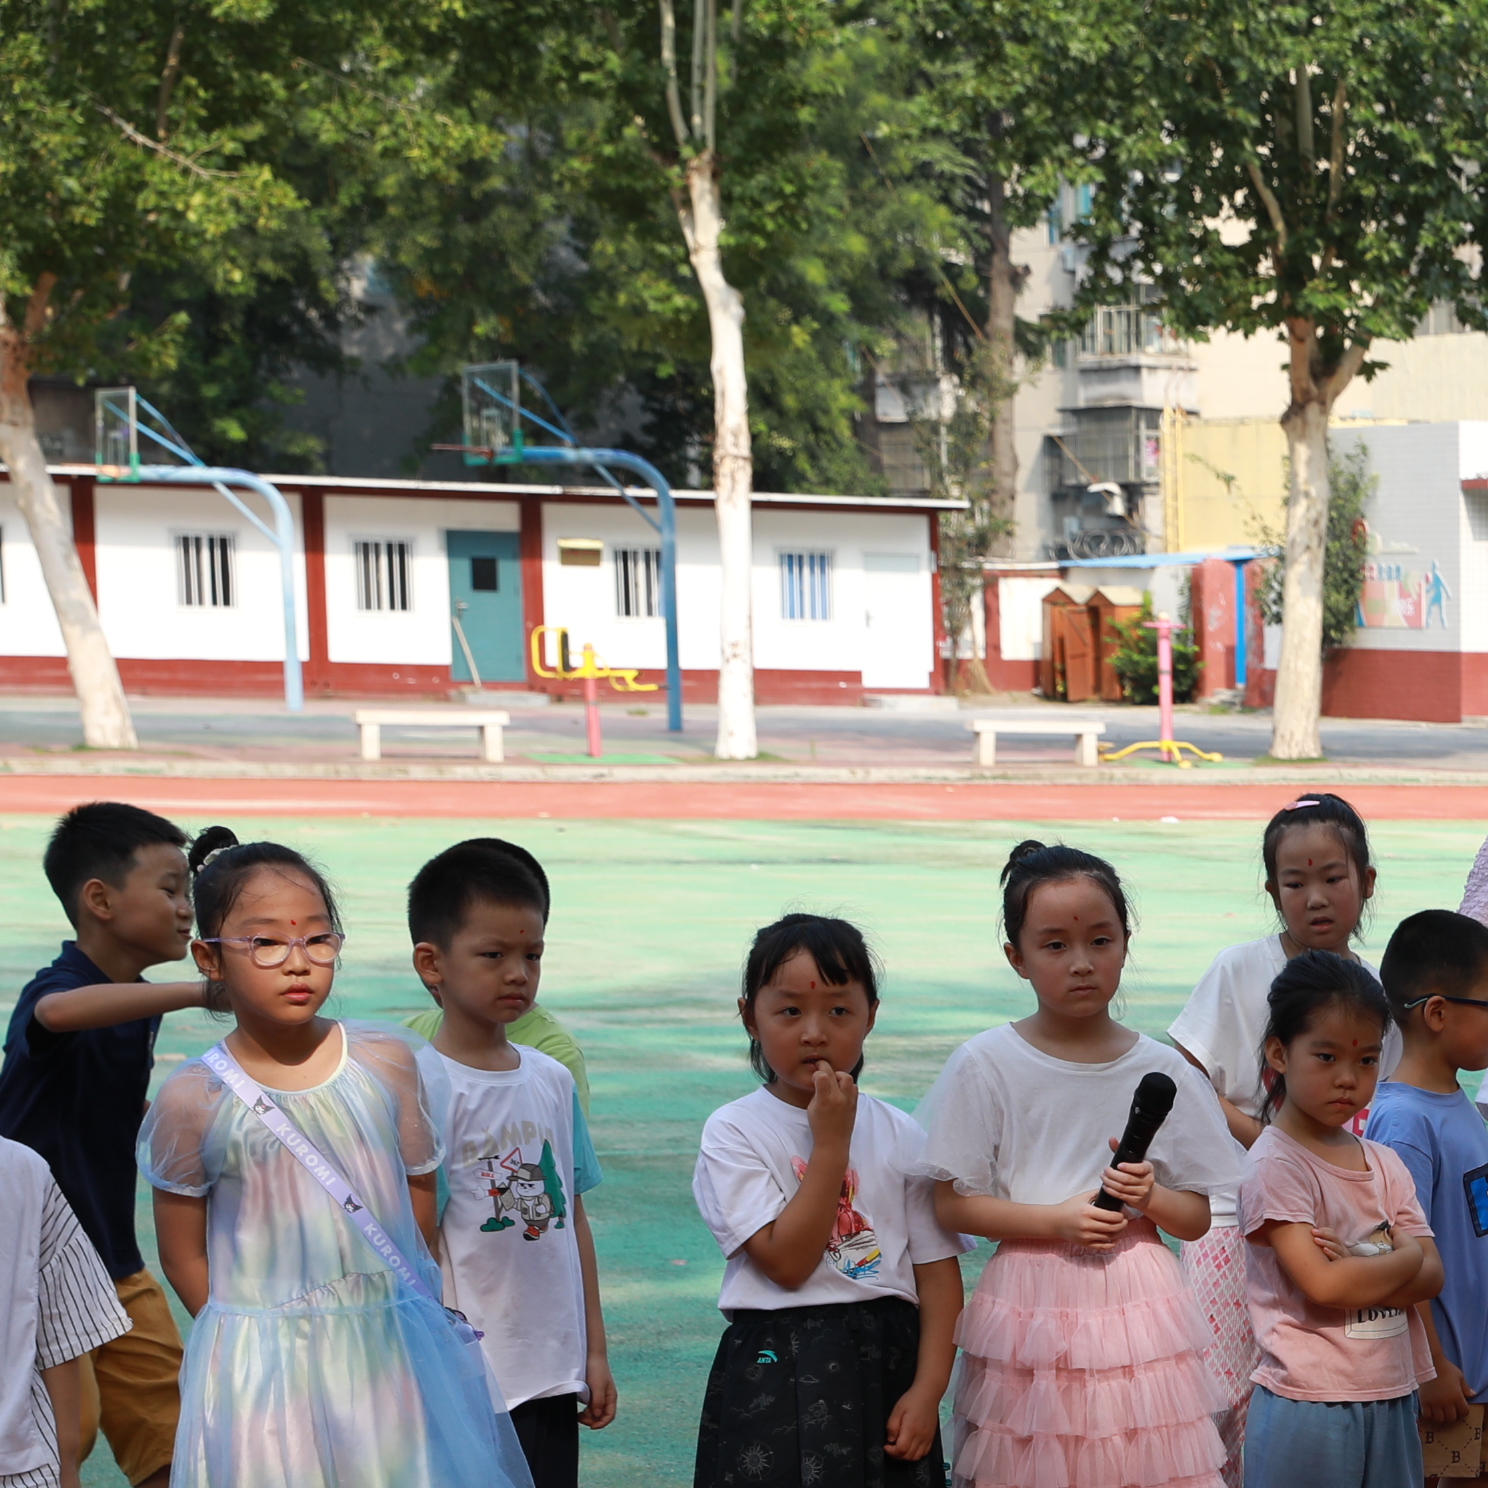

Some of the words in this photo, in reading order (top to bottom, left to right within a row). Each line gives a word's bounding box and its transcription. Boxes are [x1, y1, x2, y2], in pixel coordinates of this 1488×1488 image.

[275, 1122, 337, 1186] KUROMI
[364, 1222, 417, 1287] KUROMI
[756, 1356, 772, 1364] ANTA
